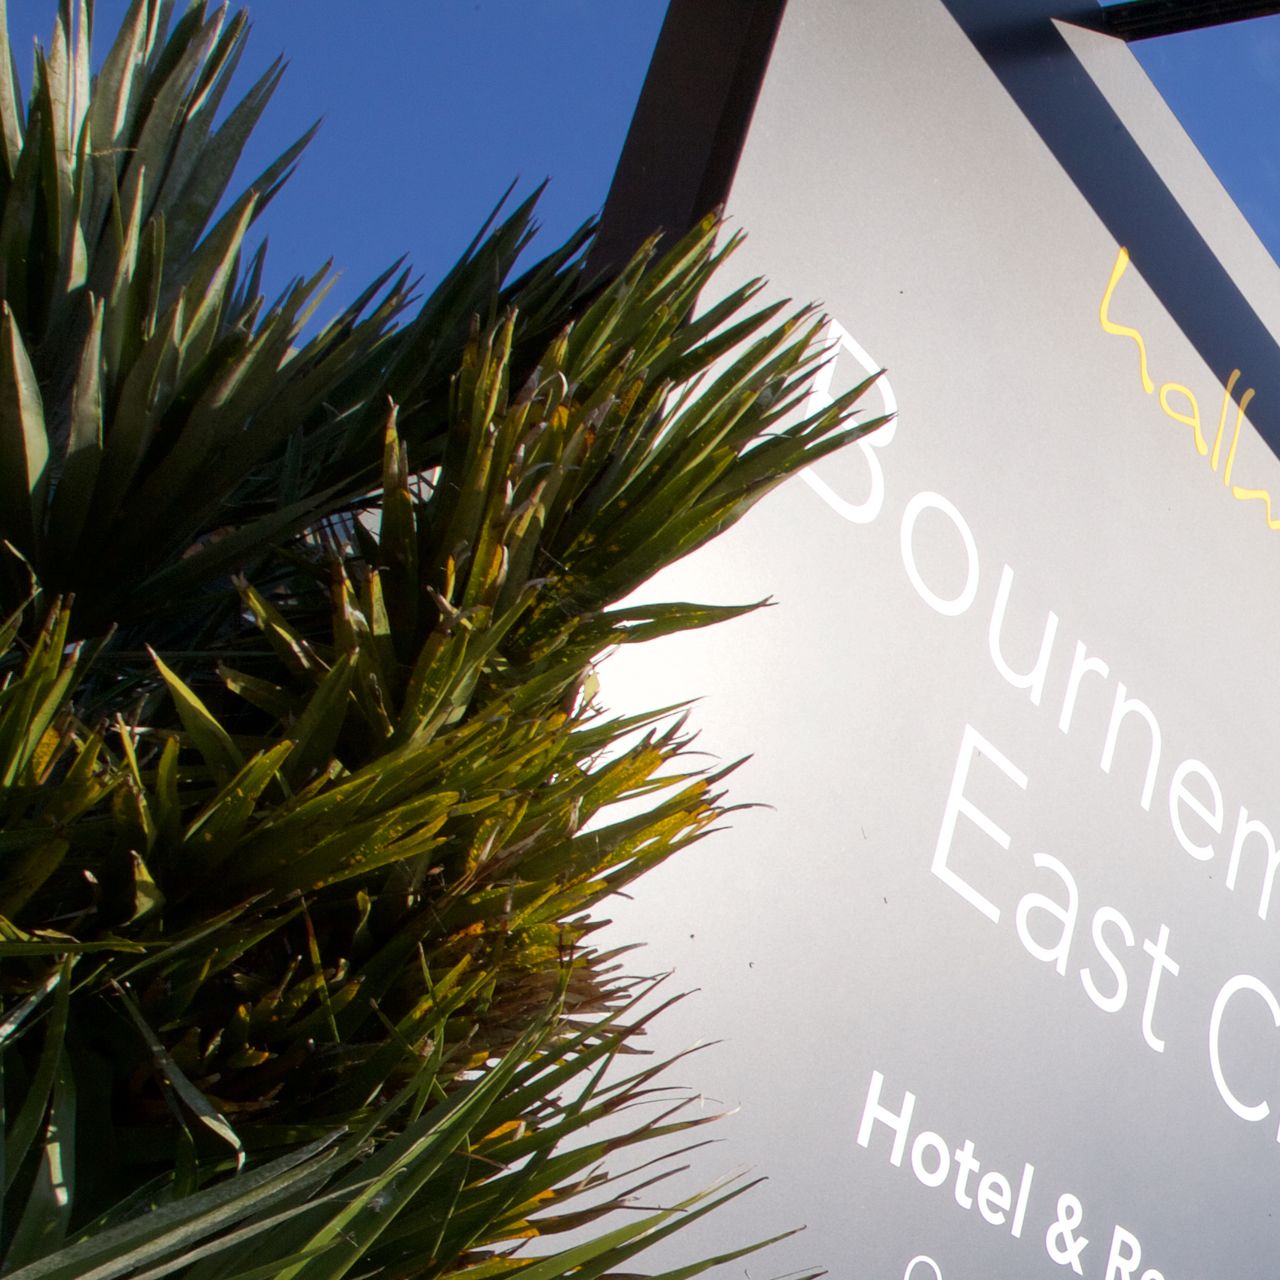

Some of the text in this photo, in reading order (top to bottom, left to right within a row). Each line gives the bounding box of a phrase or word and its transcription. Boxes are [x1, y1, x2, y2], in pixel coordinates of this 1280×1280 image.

[931, 723, 1180, 1053] East
[855, 1069, 1035, 1239] Hotel
[1045, 1193, 1089, 1276] &
